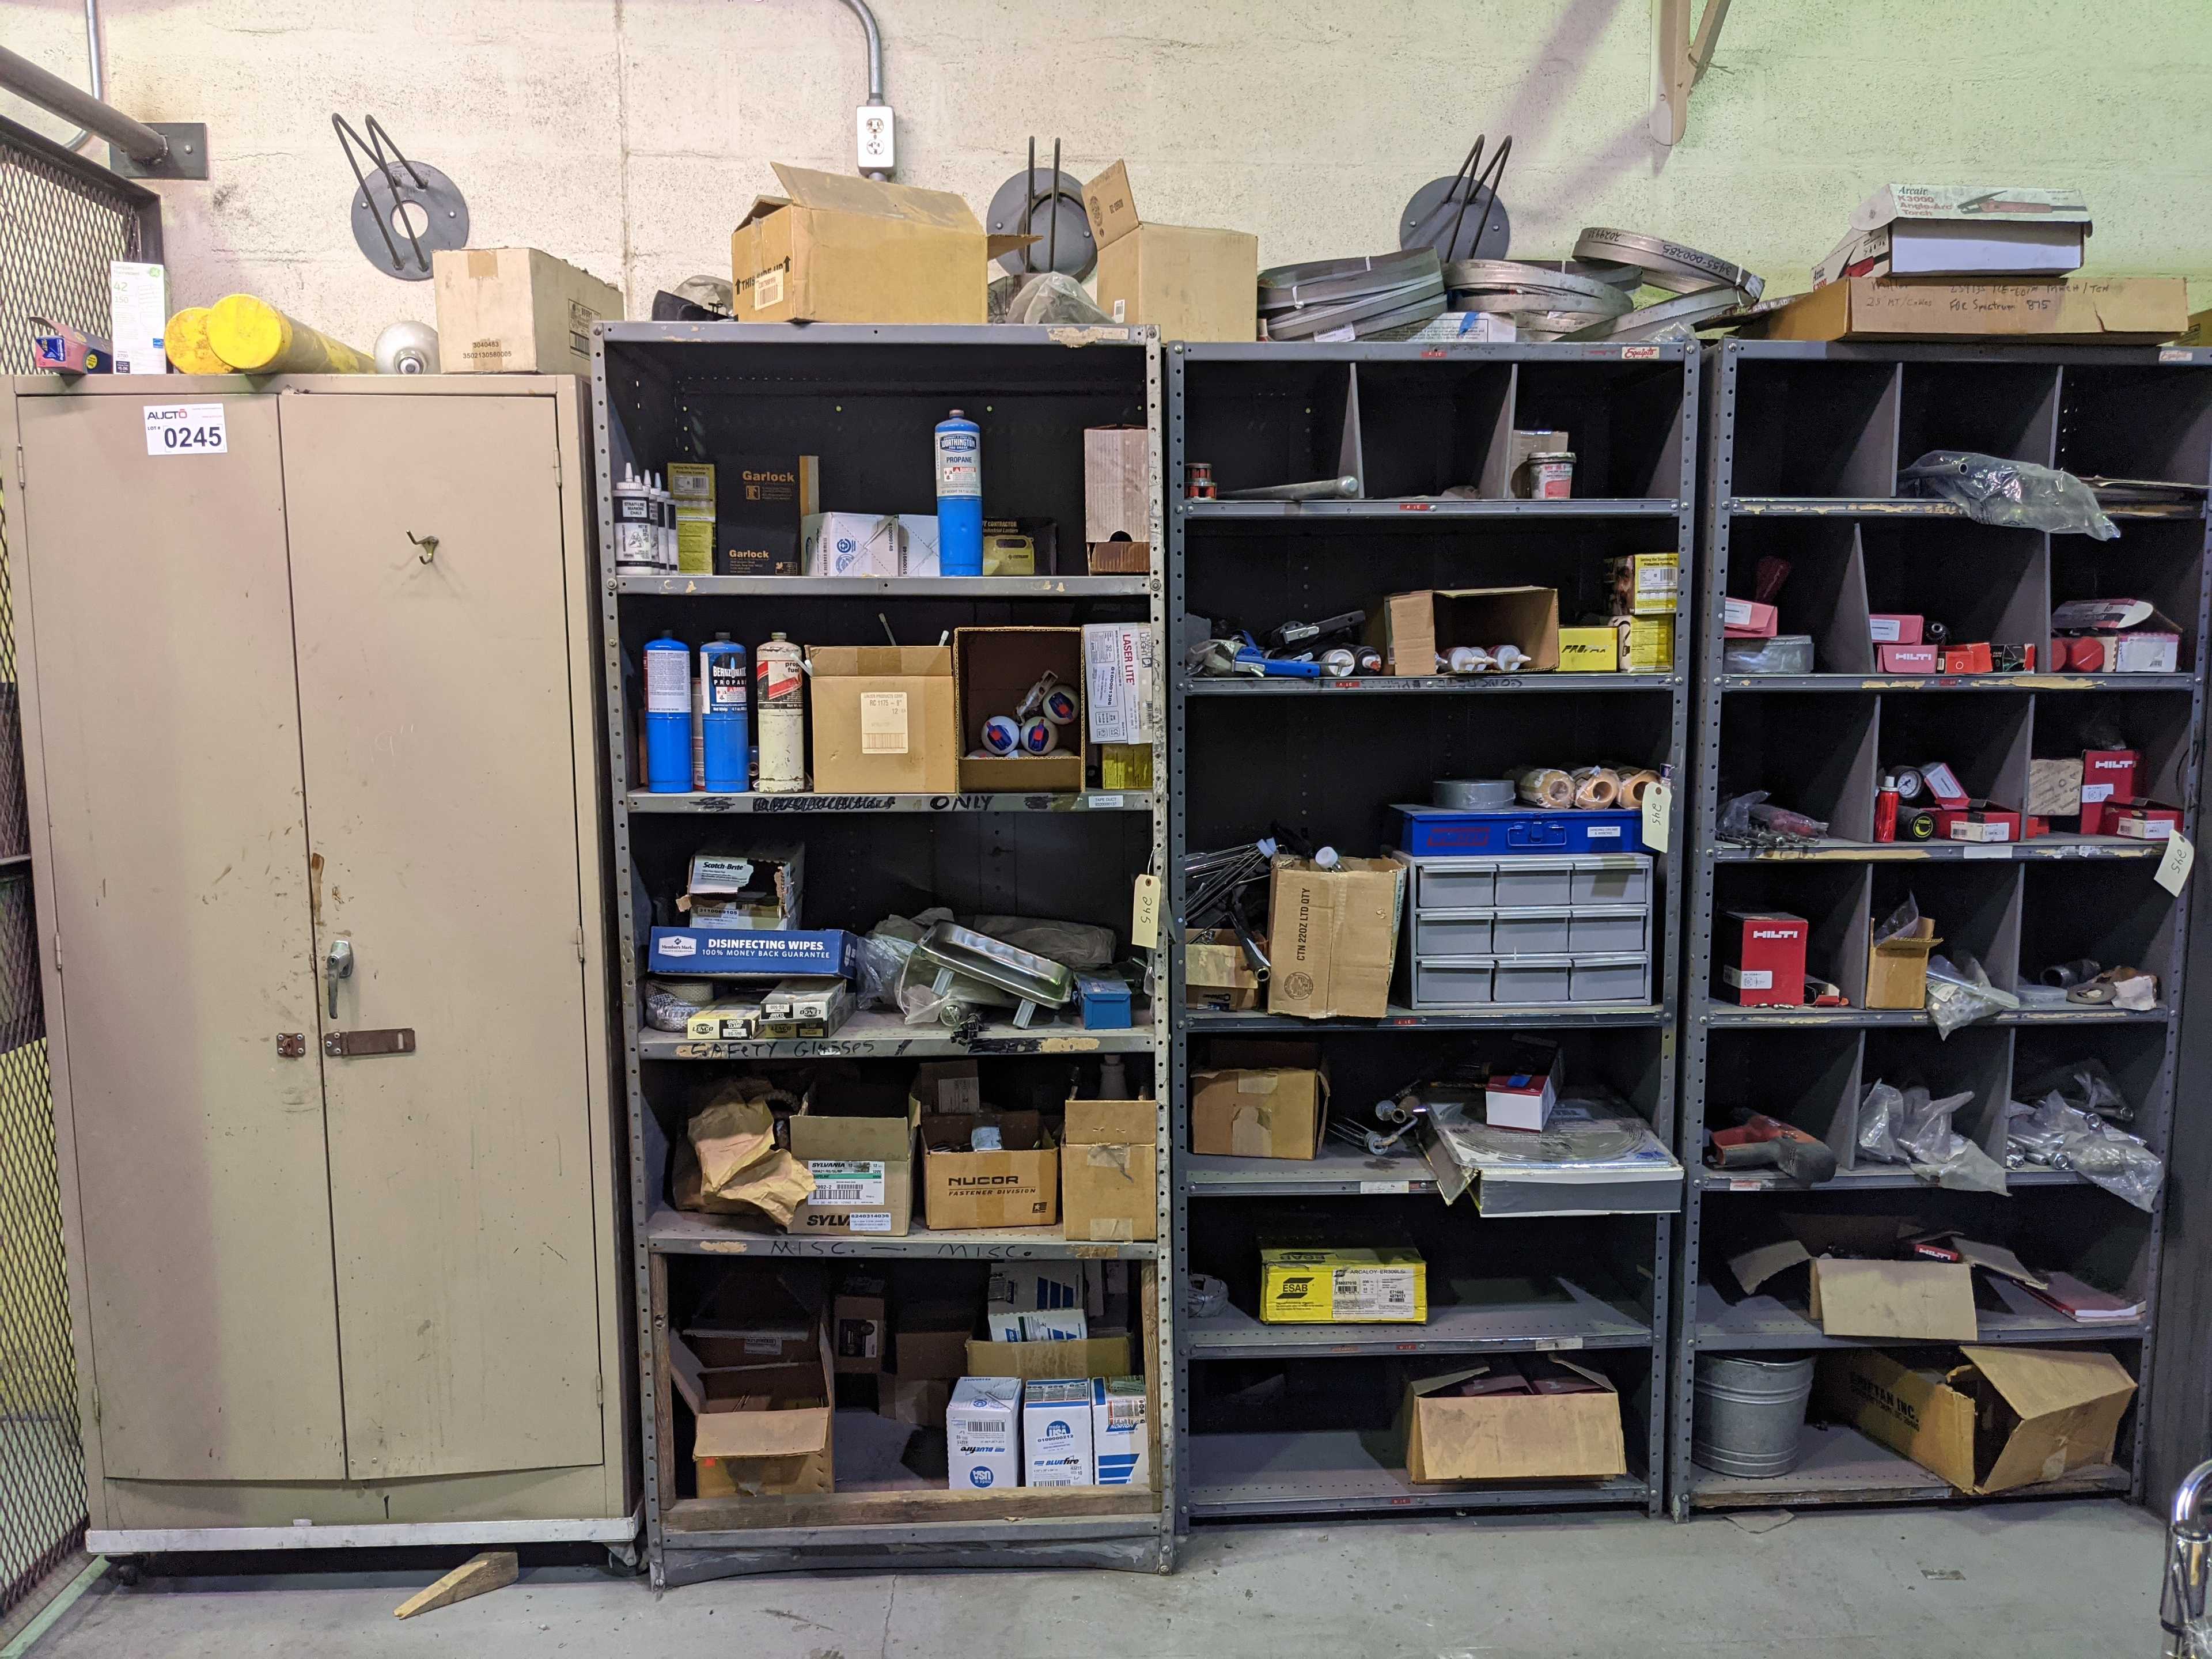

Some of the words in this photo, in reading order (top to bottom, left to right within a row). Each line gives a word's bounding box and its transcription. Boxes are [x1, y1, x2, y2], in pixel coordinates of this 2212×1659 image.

[1900, 202, 1952, 210] Angle-Arc
[113, 281, 128, 292] 42
[115, 296, 129, 304] 150
[2027, 300, 2051, 310] 875
[164, 426, 222, 449] 0245
[940, 438, 976, 449] WORTHINGTON
[742, 470, 795, 482] Garlock
[729, 549, 769, 559] Garlock
[1123, 634, 1134, 663] LASER
[1895, 653, 1931, 661] HILTI
[2094, 760, 2137, 768] HILTI
[930, 795, 994, 812] ONLY
[703, 862, 744, 870] Scotch-Brite
[1302, 888, 1310, 905] QTY
[1300, 907, 1309, 922] LTD
[1752, 930, 1798, 939] HILTI
[708, 938, 785, 950] DISINFECTING
[782, 950, 830, 959] GUARANTEE
[1297, 945, 1306, 961] CTN
[948, 1175, 1019, 1186] NUCOR
[1282, 1284, 1308, 1293] ESAB
[972, 1470, 991, 1480] USA
